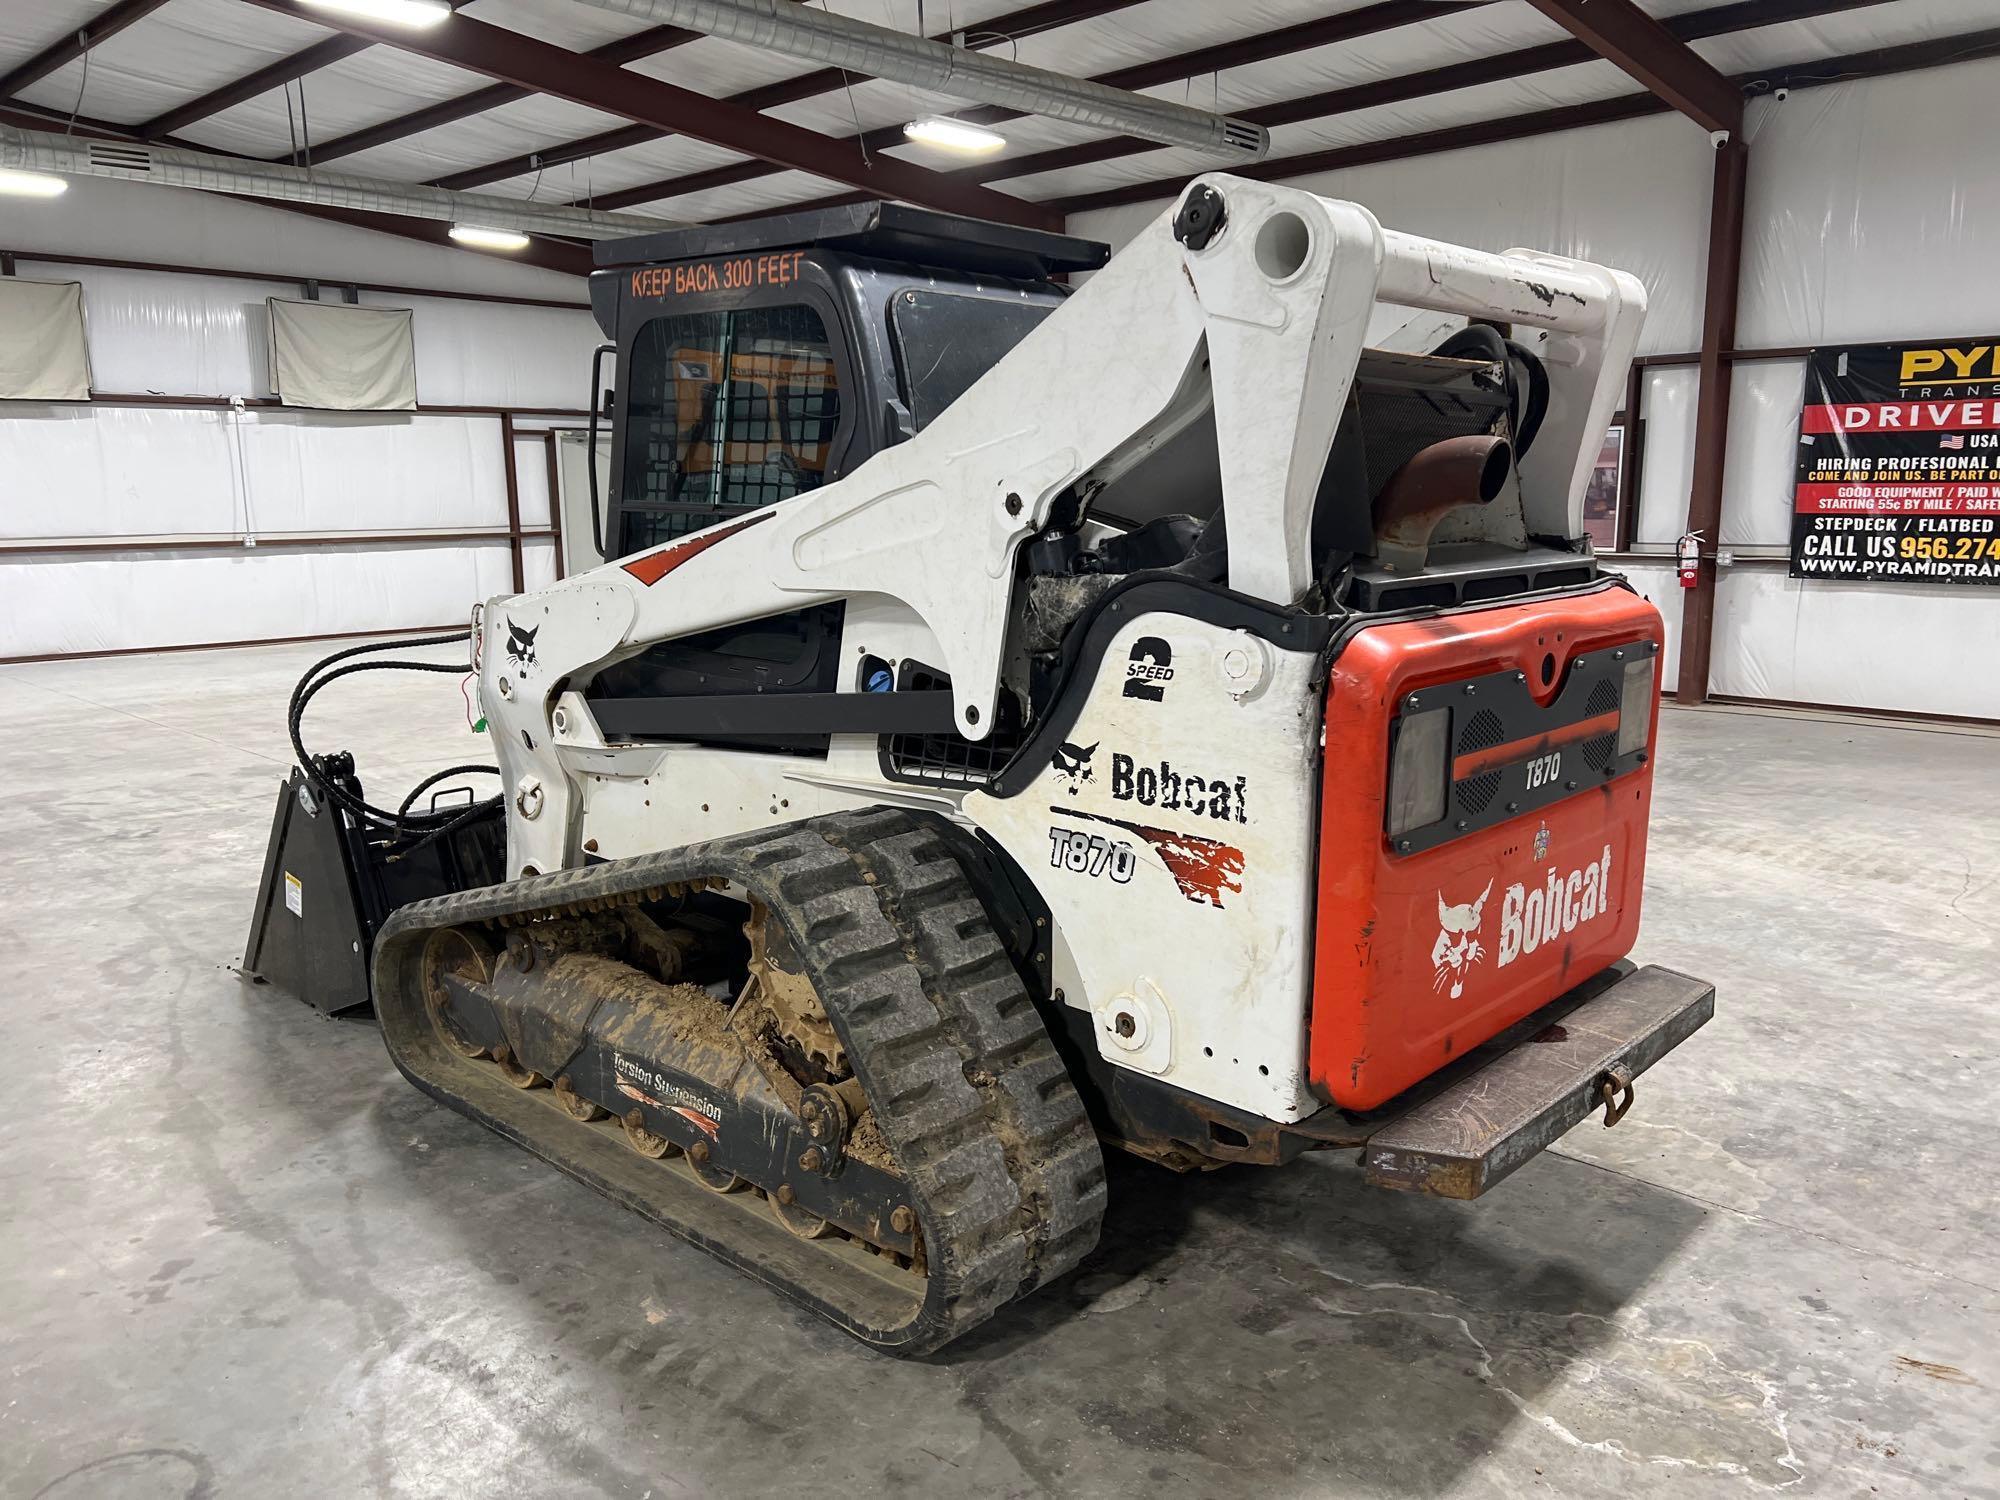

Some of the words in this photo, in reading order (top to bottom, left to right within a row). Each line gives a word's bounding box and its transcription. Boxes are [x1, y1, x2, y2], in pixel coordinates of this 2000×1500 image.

[632, 267, 671, 297] KEEP
[723, 259, 752, 289] 300
[757, 252, 805, 284] FEET
[1900, 345, 2000, 380] PY
[1970, 434, 1999, 449] USA
[1808, 471, 1840, 481] COME
[1844, 471, 1869, 481] AND
[1873, 471, 1900, 481] JOIN
[1905, 470, 1925, 481] US.
[1930, 470, 1946, 481] BE
[1951, 470, 1985, 480] PART
[1989, 470, 2000, 480] O
[1817, 457, 1872, 471] HIRING
[1877, 456, 1989, 470] PROFESIONAL
[1819, 498, 1875, 509] STARTING
[1904, 499, 1921, 510] BY
[1923, 499, 1952, 510] MILE
[1955, 499, 1962, 510] /
[1838, 486, 1872, 498] GOOD
[1875, 486, 1945, 499] EQUIPMENT
[1947, 487, 1954, 498] /
[1957, 487, 1988, 498] PAID
[1814, 517, 1897, 531] STEPDECK
[1903, 519, 1912, 531] /
[1918, 519, 1994, 533] FLATBED
[1804, 534, 1857, 557] CALL
[1867, 536, 1896, 558] US
[1900, 536, 2000, 560] 956.274
[1126, 663, 1174, 681] SPEED
[1526, 752, 1561, 790] T870
[1112, 753, 1247, 824] Bobcat
[1050, 827, 1136, 883] T870
[1498, 844, 1612, 968] Bobcat
[613, 1051, 652, 1086] Torsion
[655, 1073, 722, 1122] Suspension
